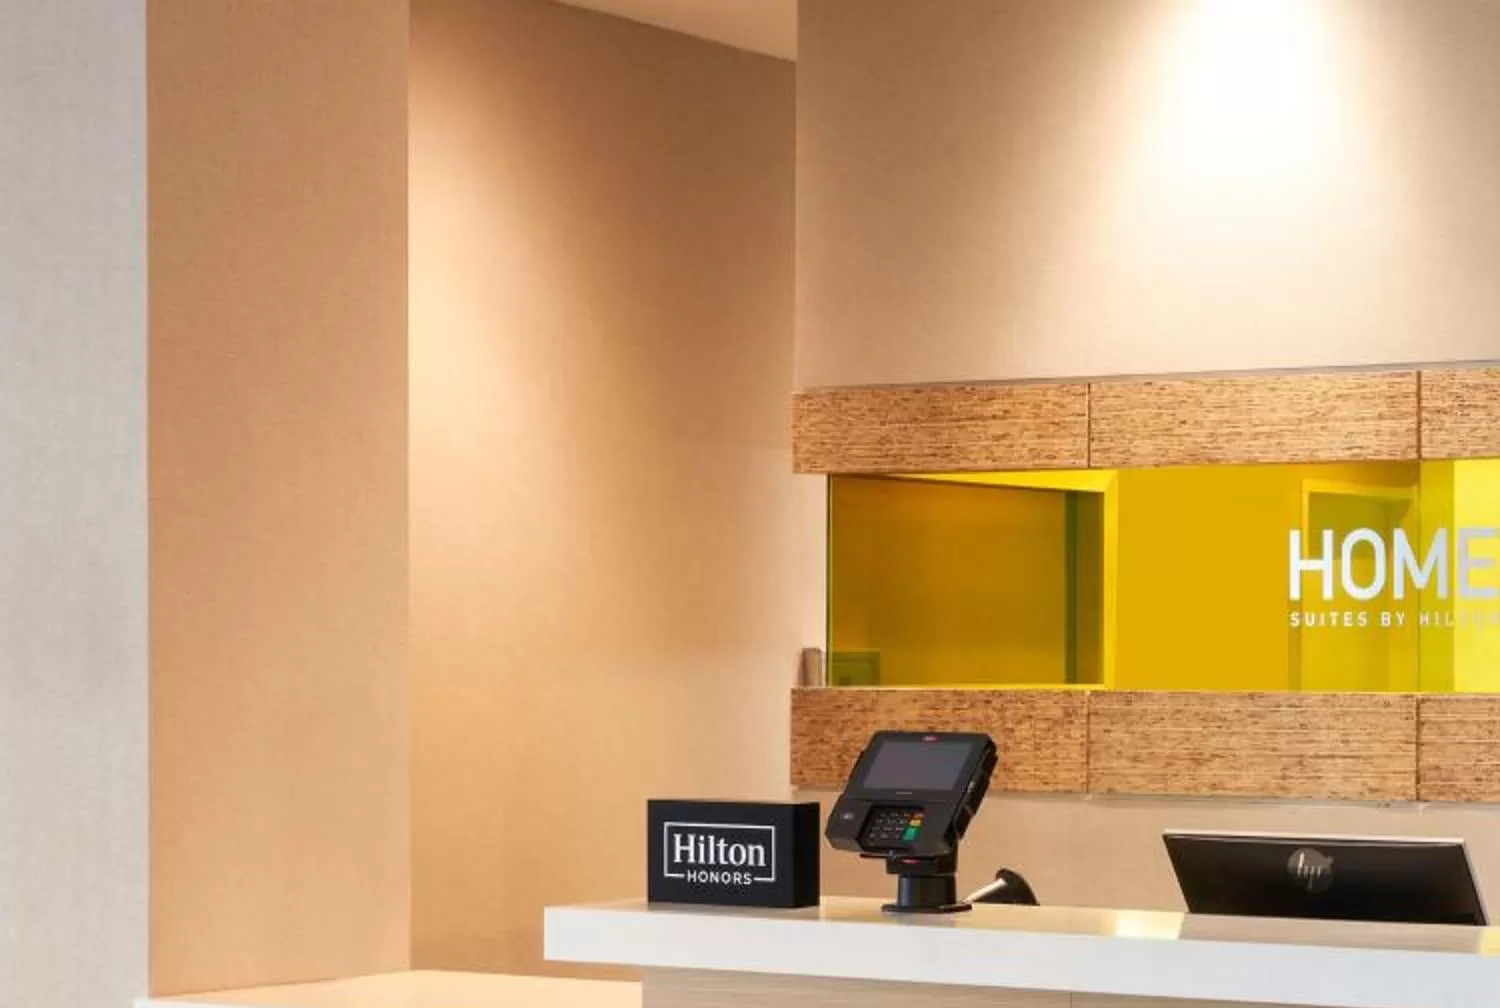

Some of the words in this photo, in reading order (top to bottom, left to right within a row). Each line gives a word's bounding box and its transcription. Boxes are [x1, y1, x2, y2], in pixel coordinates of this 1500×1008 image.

[1288, 611, 1369, 628] SUITES
[1379, 611, 1406, 628] BY
[673, 833, 767, 867] Hilton
[686, 869, 754, 885] HONORS
